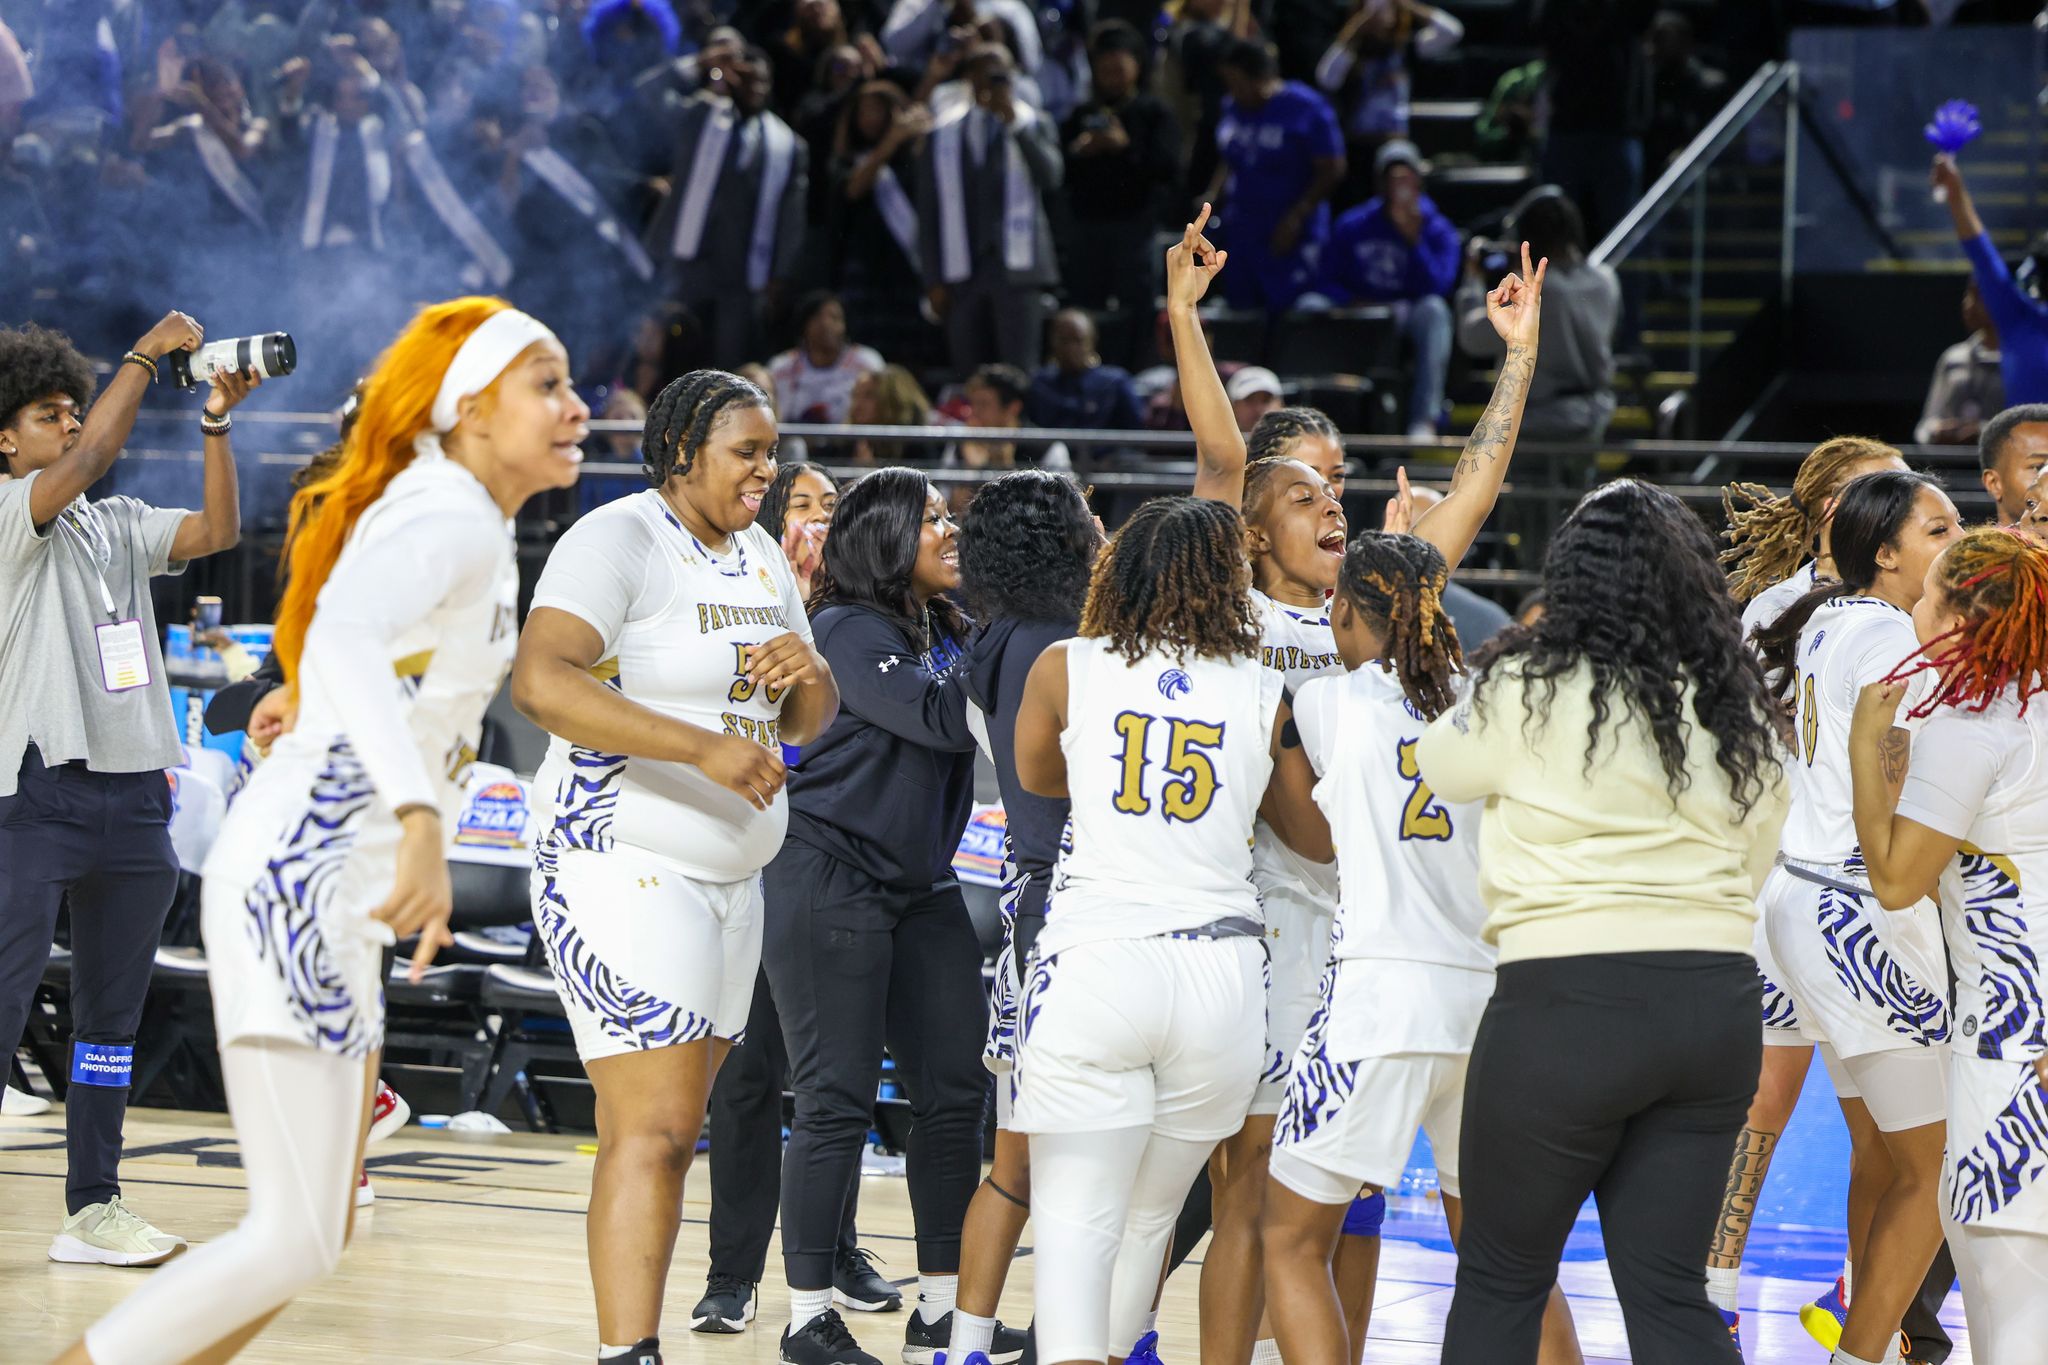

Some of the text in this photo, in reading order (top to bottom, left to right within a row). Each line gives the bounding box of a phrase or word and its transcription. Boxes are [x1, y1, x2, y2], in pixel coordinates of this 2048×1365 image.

[1110, 710, 1226, 825] 15
[1396, 736, 1453, 842] 2
[85, 1053, 107, 1063] CIAA
